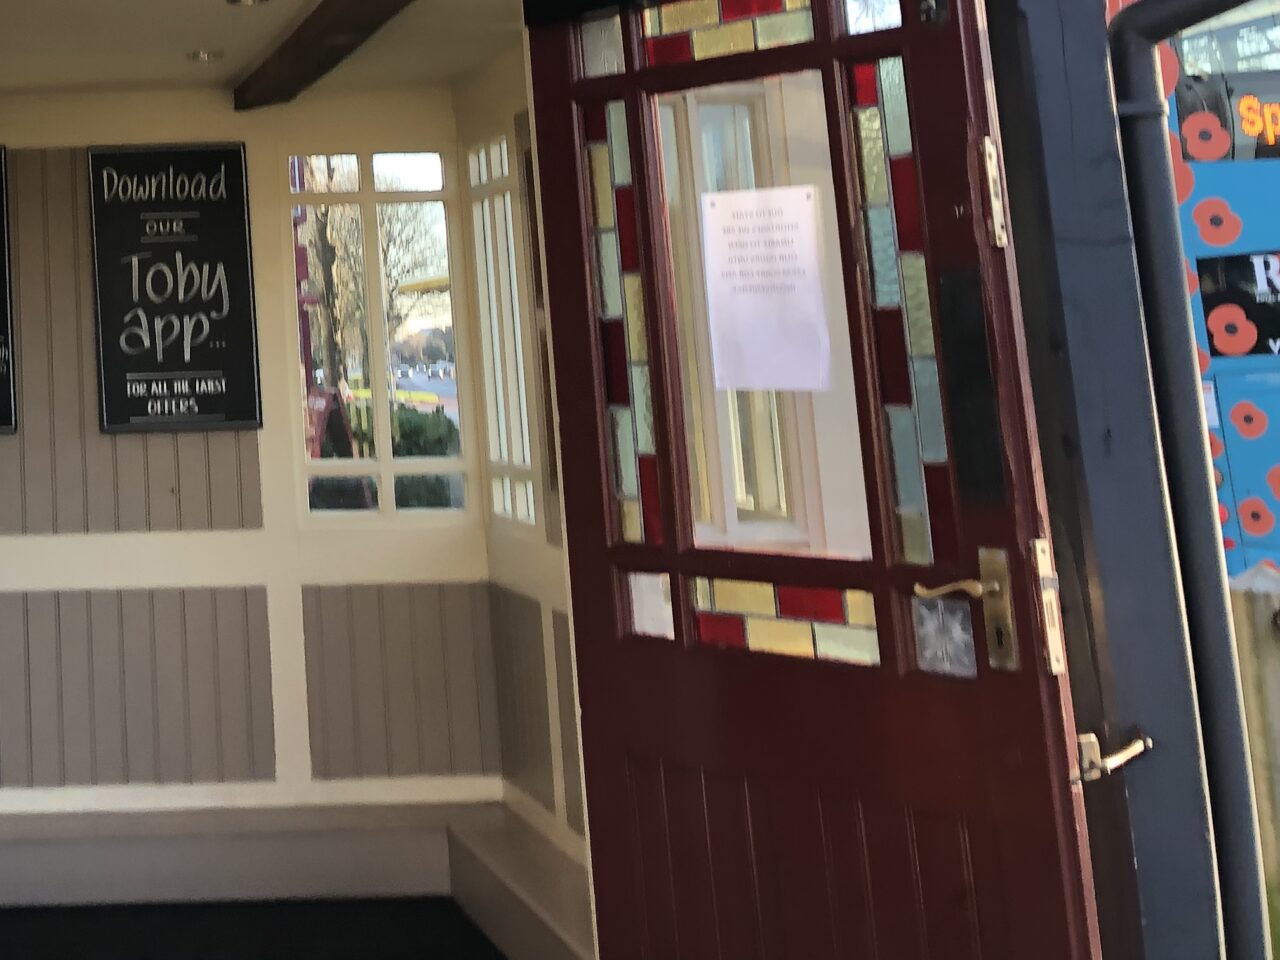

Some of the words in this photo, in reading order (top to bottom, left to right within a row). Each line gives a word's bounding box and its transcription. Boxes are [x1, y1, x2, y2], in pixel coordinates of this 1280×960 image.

[103, 162, 228, 203] Download
[146, 218, 186, 235] OUR
[121, 251, 230, 320] Toby
[126, 380, 148, 398] FOR
[151, 380, 170, 397] ALL
[173, 378, 193, 396] THE
[147, 396, 199, 416] OFFERS
